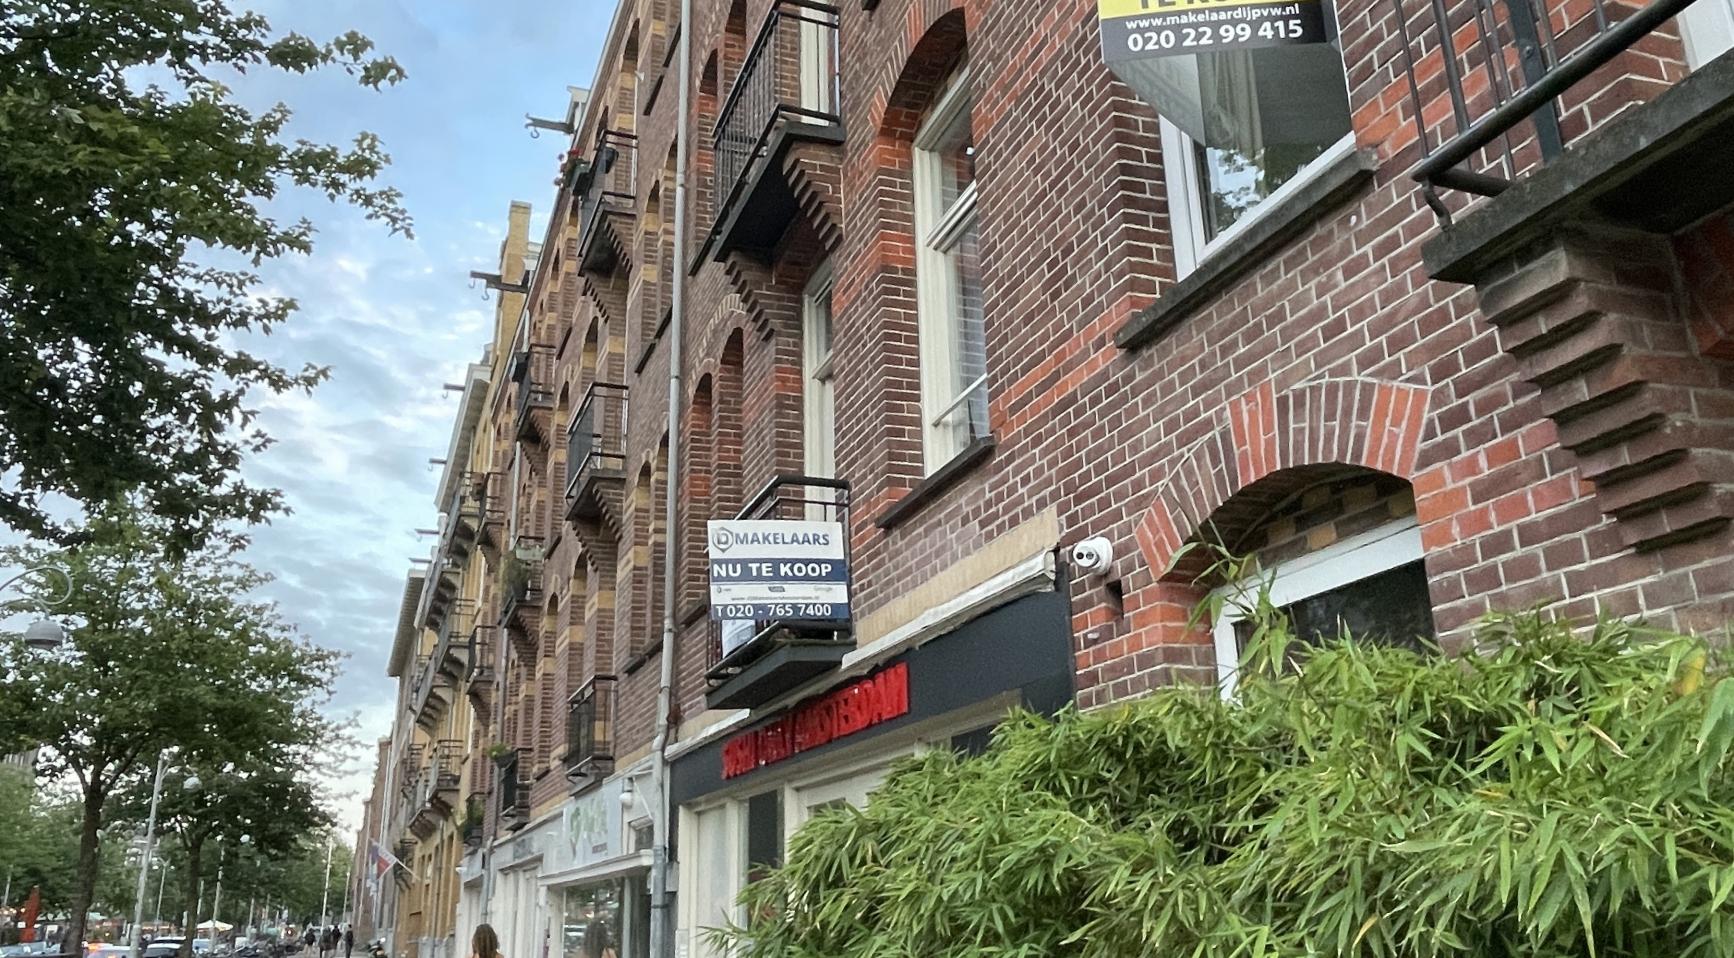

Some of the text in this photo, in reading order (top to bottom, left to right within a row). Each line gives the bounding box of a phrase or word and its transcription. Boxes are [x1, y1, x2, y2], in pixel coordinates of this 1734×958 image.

[1125, 3, 1300, 29] www.makelaardijpvw.nl
[1127, 19, 1303, 52] 020 22 99 415
[735, 532, 830, 546] MAKELAARS
[713, 563, 832, 577] NU TE KOOP
[716, 606, 724, 617] T
[726, 605, 754, 617] 020
[767, 604, 793, 616] 765
[799, 603, 831, 616] 7400
